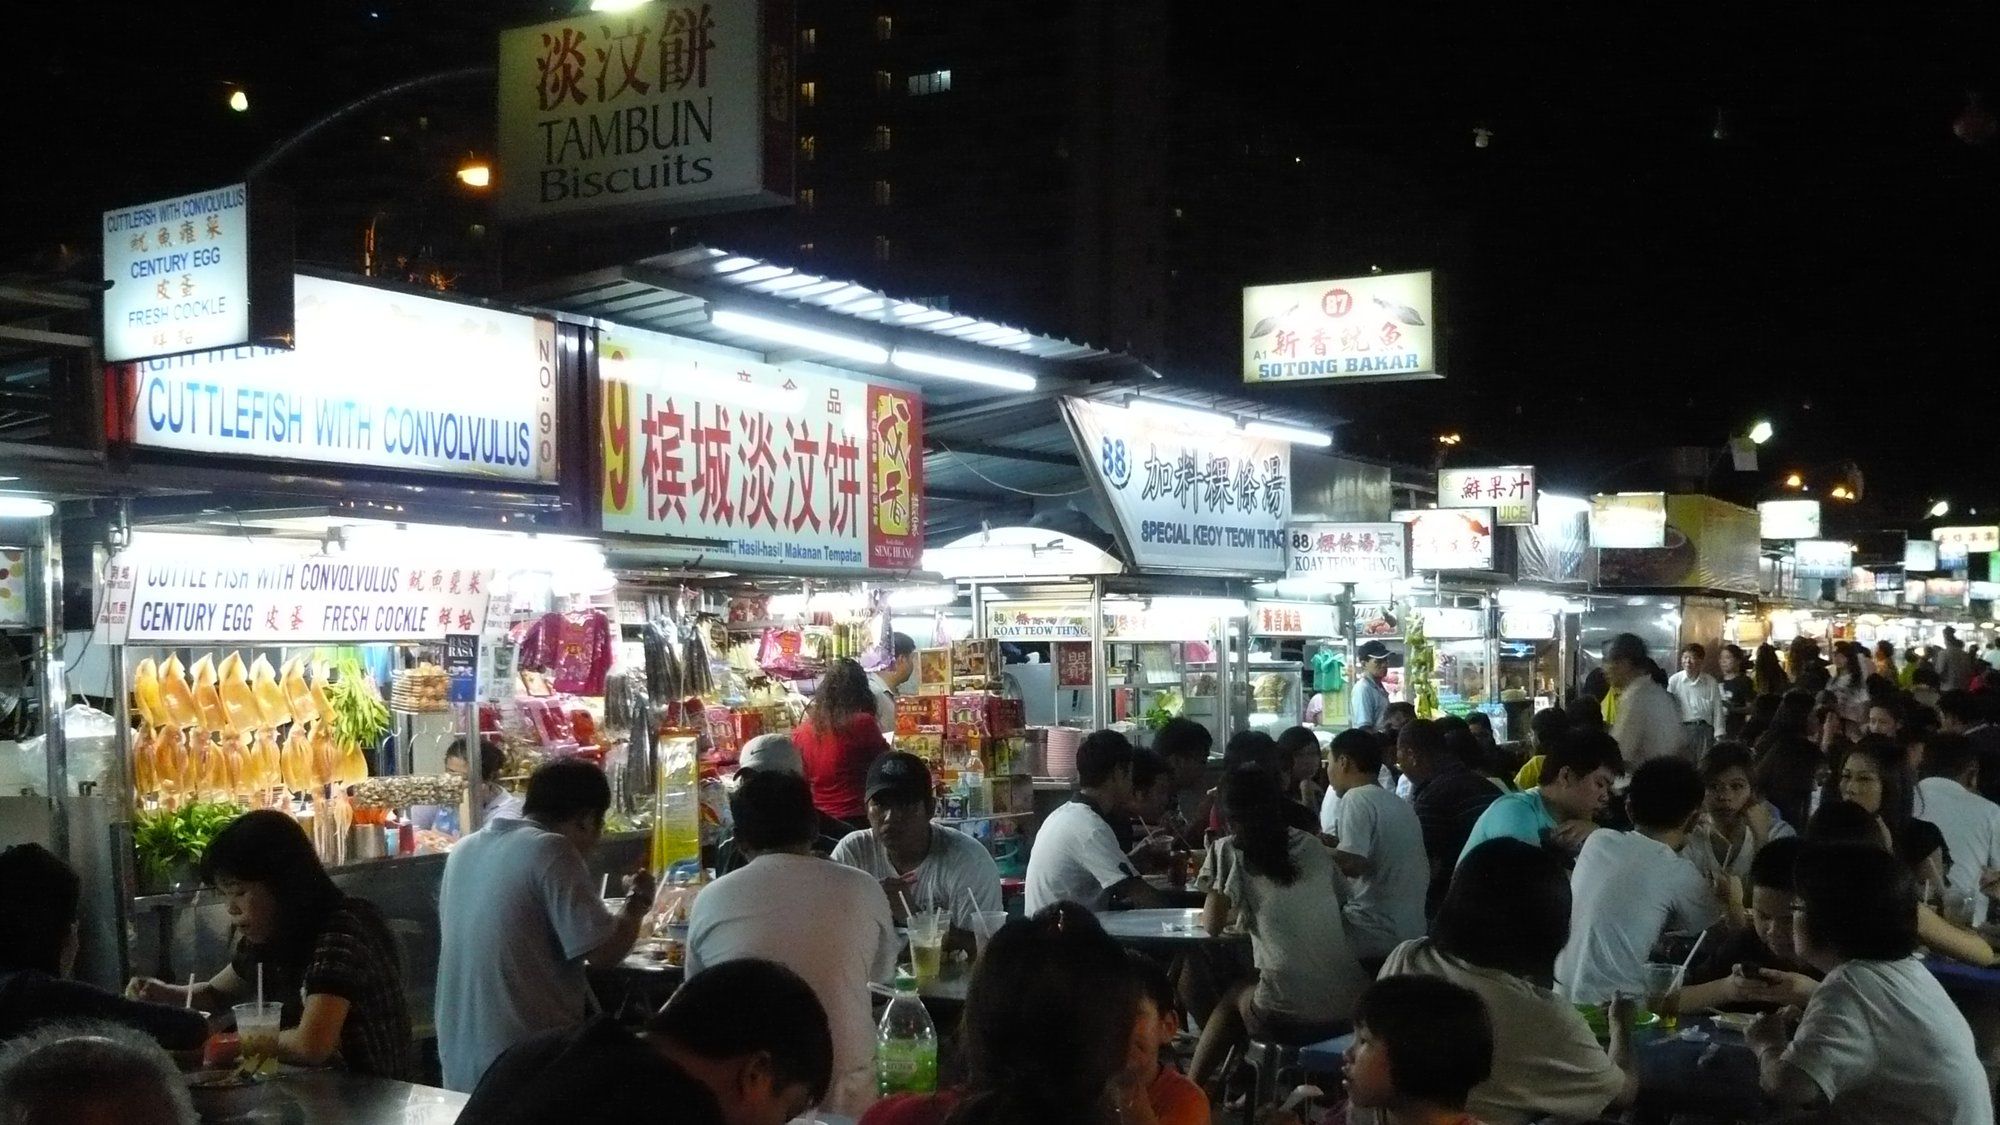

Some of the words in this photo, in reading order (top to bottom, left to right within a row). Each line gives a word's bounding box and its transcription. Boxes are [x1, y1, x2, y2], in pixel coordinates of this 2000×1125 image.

[536, 4, 716, 111] 淡汶餅
[538, 96, 713, 164] TAMBUN
[539, 154, 713, 202] Biscuits
[107, 209, 157, 233] CUTTLEFISH
[159, 204, 181, 223] WITH
[182, 188, 245, 218] CONVOLVULUS
[131, 252, 188, 279] CENTURY
[193, 247, 221, 268] EGG
[129, 307, 169, 329] FRESH
[174, 296, 227, 321] COCKLE
[1258, 360, 1338, 379] SOTONG
[1345, 354, 1420, 373] BAKAR
[148, 378, 302, 444] CUTTLEFISH
[315, 402, 372, 449] WITH
[384, 407, 531, 467] CONVOLVULUS
[641, 393, 861, 538] 槟城淡汶饼
[1102, 436, 1127, 480] 88
[1499, 504, 1527, 519] UICE
[1141, 520, 1190, 545] SPECIAL
[1193, 525, 1222, 546] KEOY
[1225, 527, 1255, 548] TEOW
[1292, 533, 1309, 549] 88
[739, 539, 783, 558] Hasil-hasil
[785, 542, 822, 560] Makanan
[824, 545, 862, 565] Tempatan
[1294, 556, 1323, 572] KOAY
[147, 563, 207, 588] CUTTLE
[215, 563, 249, 589] FISH
[256, 563, 295, 590] WITH
[300, 563, 399, 593] CONVOLVULUS
[140, 602, 217, 632] CENTURY
[223, 604, 253, 631] EGG
[264, 604, 304, 631] 皮蛋
[323, 606, 369, 632] FRESH
[375, 606, 429, 632] COCKLE
[993, 626, 1020, 636] KOAY
[1024, 626, 1053, 635] TEOW
[449, 647, 474, 657] RASA
